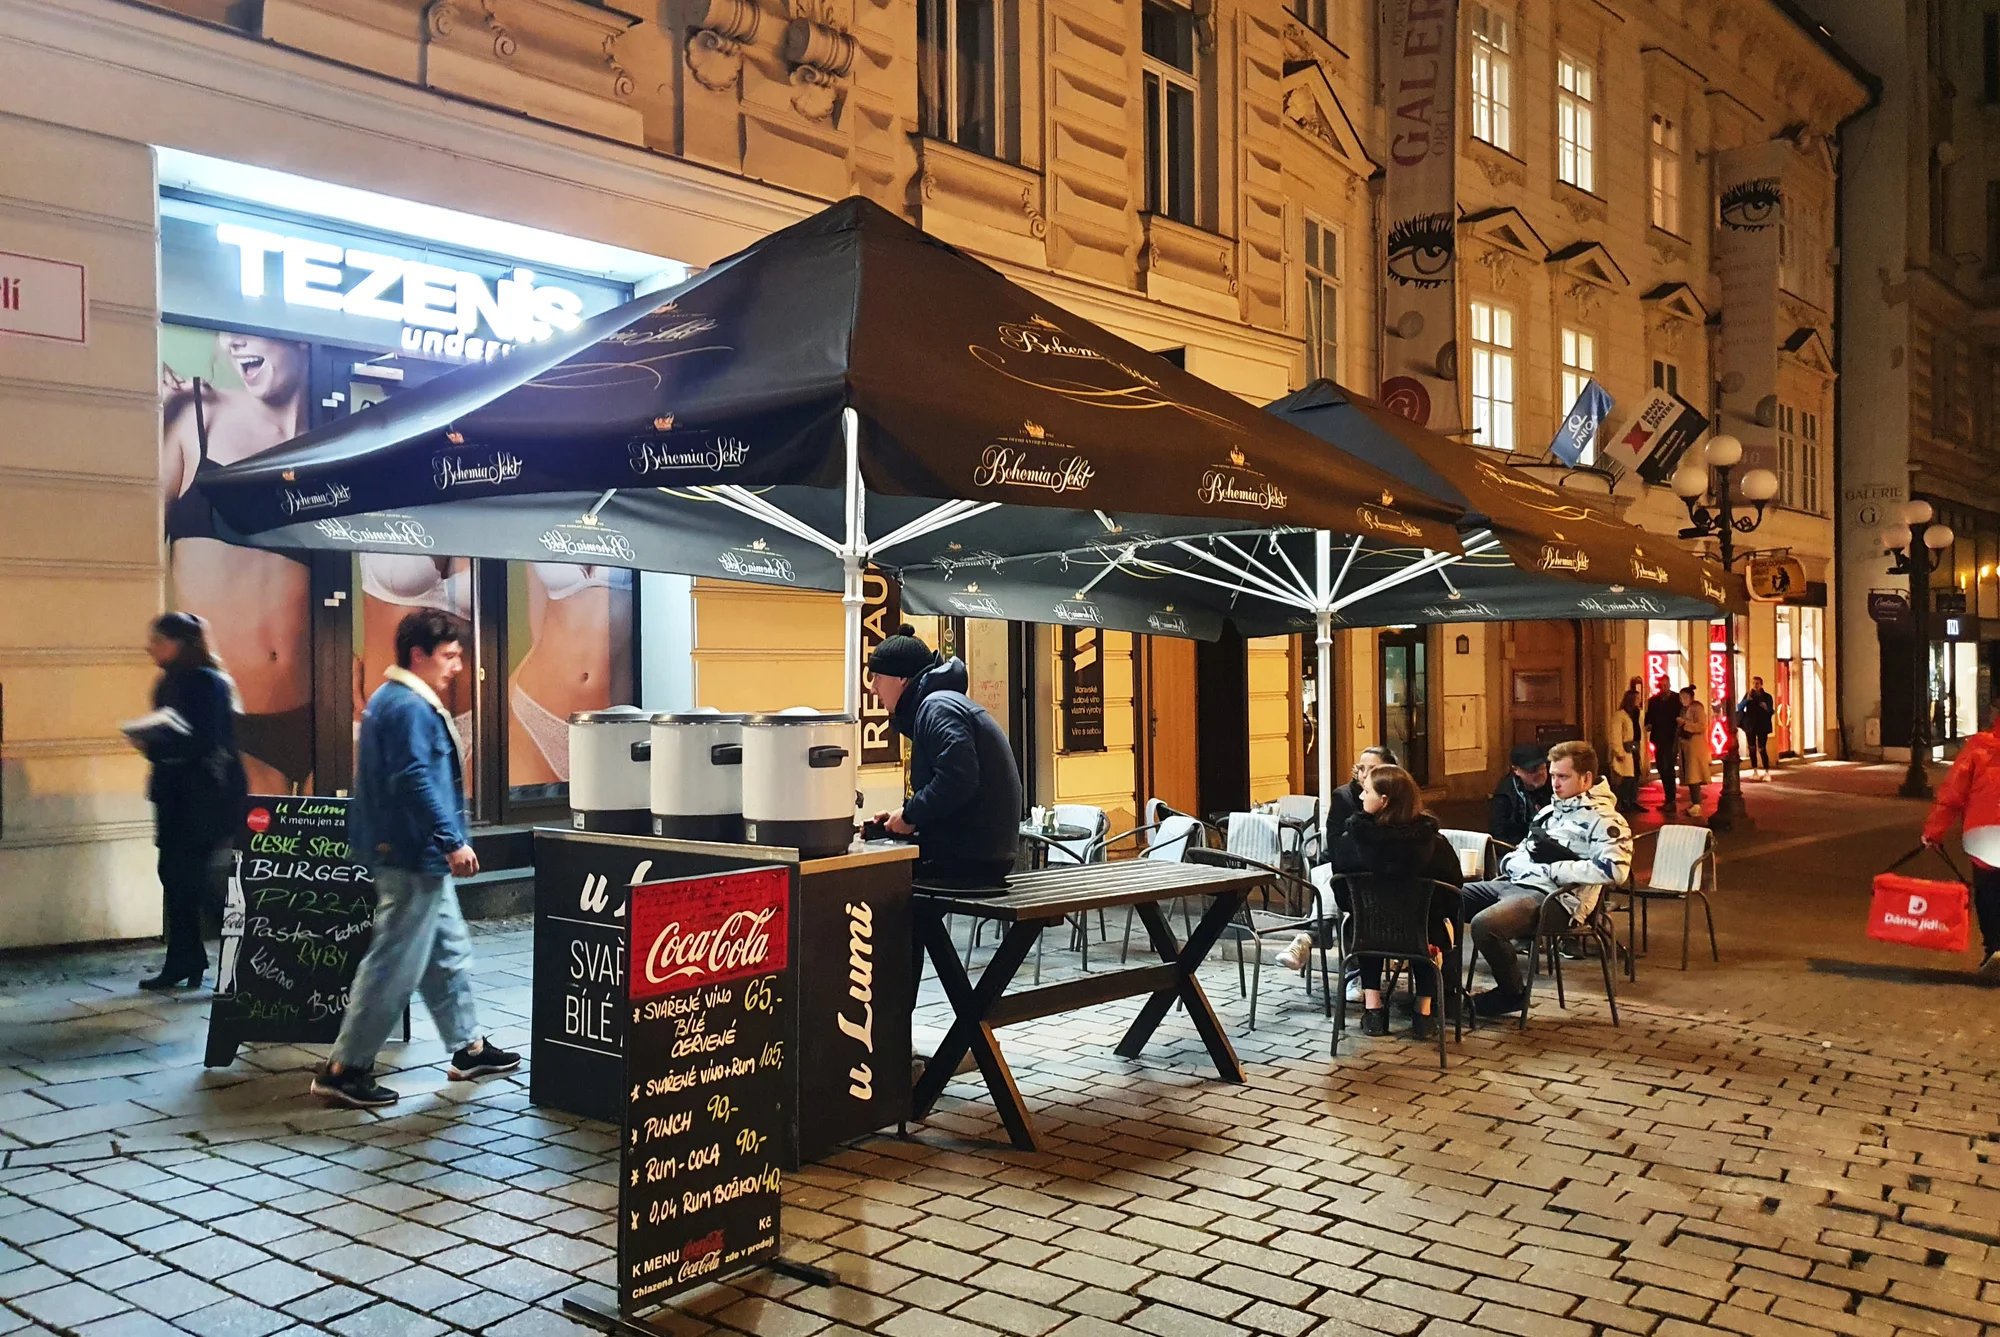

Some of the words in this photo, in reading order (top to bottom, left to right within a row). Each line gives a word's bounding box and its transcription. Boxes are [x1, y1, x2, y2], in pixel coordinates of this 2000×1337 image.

[0, 277, 21, 311] lí
[1000, 325, 1104, 360] Bohem
[1641, 398, 1660, 422] BRNO
[1646, 400, 1666, 426] EXPAT
[1652, 401, 1676, 429] CENTRE
[432, 455, 490, 490] Bohemia
[487, 451, 523, 484] Sekt
[628, 440, 707, 475] Bohemia
[704, 435, 750, 472] Sekt
[974, 444, 1053, 488] Bohemia
[1051, 455, 1095, 493] Sekt
[281, 486, 328, 516] Bohemia
[1198, 470, 1259, 505] Bohemia
[1258, 483, 1288, 510] Sekt
[280, 816, 287, 825] K
[288, 818, 315, 826] menu
[317, 816, 332, 827] jen
[334, 818, 346, 827] za
[245, 859, 375, 884] BURGER
[580, 872, 609, 914] u
[249, 915, 324, 944] Pasta
[645, 906, 778, 985] Coca-Cola
[836, 901, 873, 1053] Lumi
[565, 987, 614, 1043] BÍLÉ
[673, 1010, 707, 1038] BÍLÉ
[849, 1062, 873, 1101] u
[643, 1109, 694, 1144] PUNCH
[649, 1197, 678, 1226] 0,04
[682, 1189, 711, 1215] RUM
[758, 1216, 772, 1231] Kč
[632, 1263, 641, 1279] K
[644, 1249, 680, 1275] MENU
[632, 1275, 674, 1299] Chlazená
